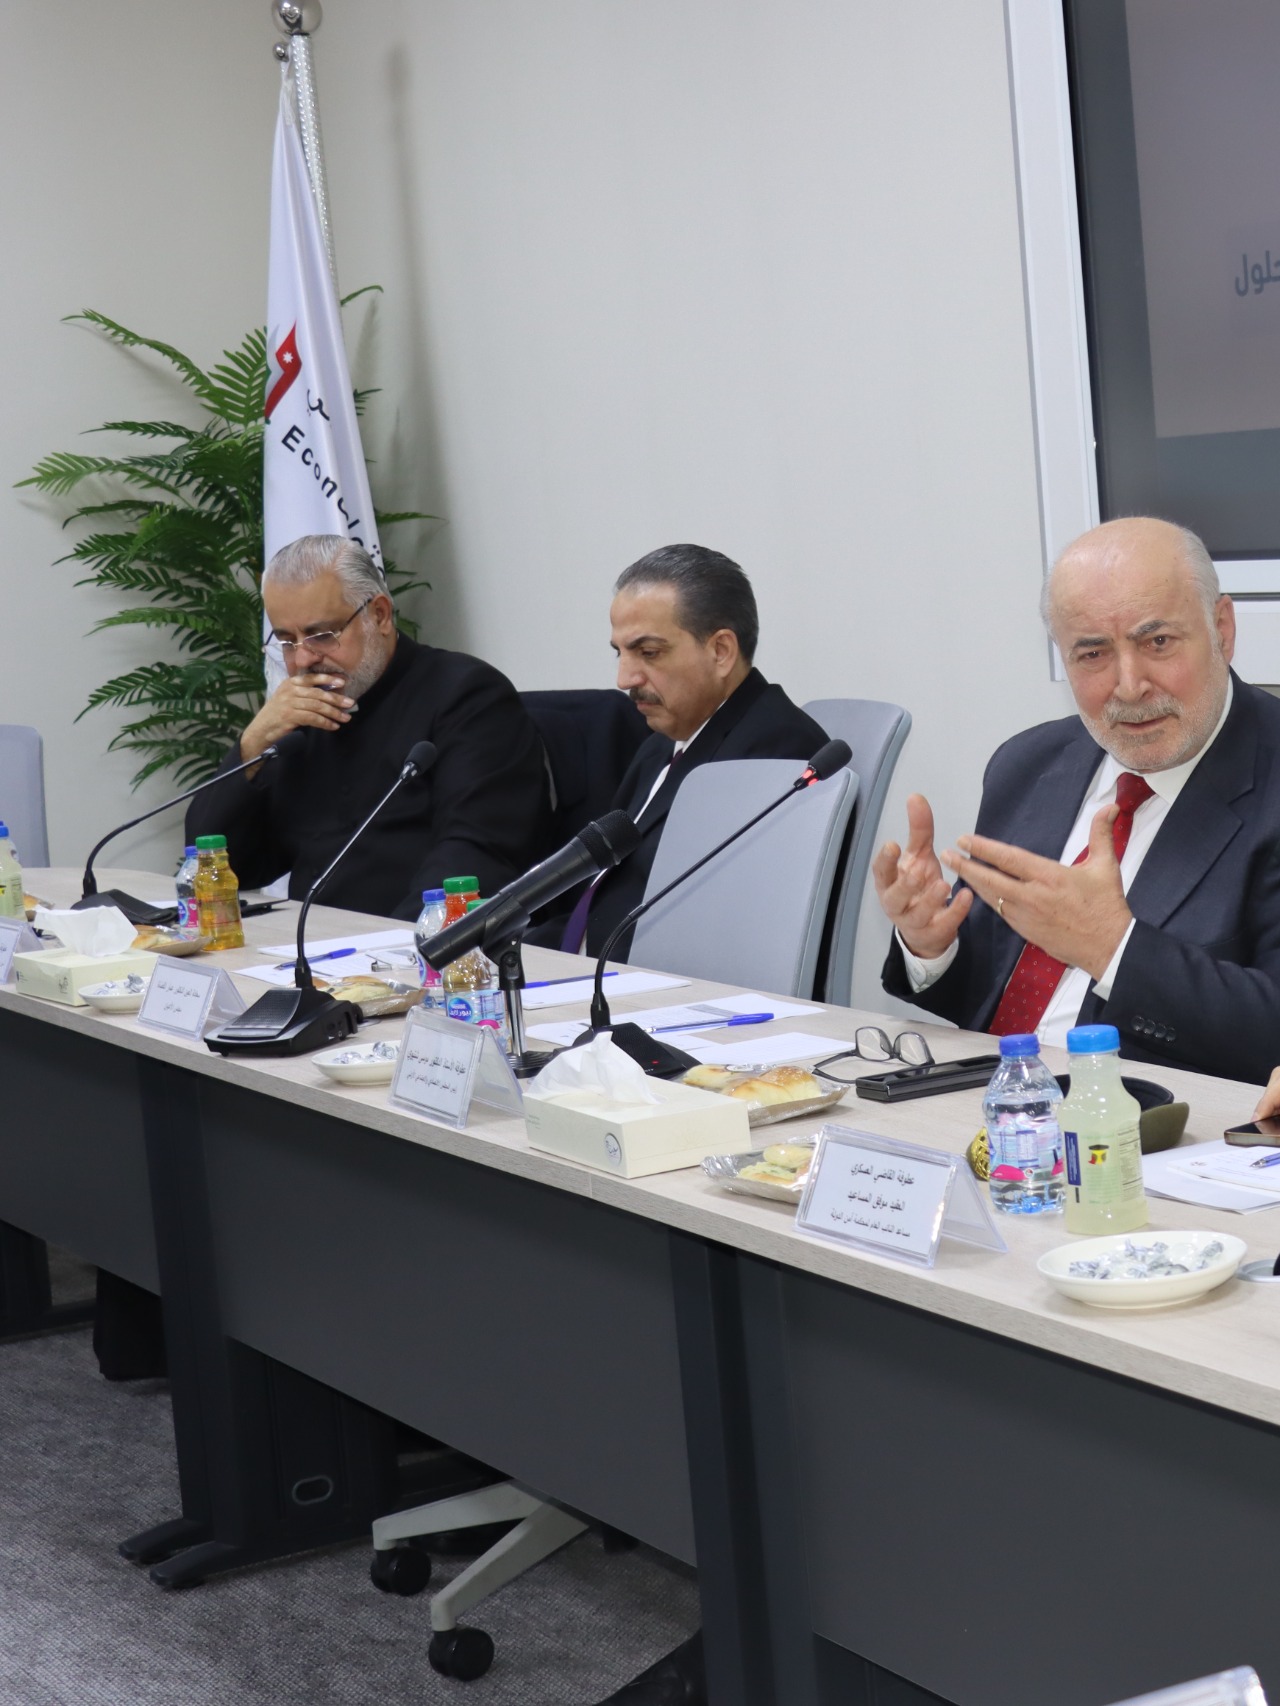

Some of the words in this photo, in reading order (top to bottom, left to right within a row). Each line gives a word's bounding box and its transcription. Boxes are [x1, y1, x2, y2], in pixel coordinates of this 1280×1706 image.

[850, 1163, 874, 1176] العسكري
[873, 1166, 896, 1183] القاضي
[897, 1169, 914, 1186] عطوفة
[848, 1191, 872, 1203] المساعيد
[872, 1194, 888, 1210] موفق
[889, 1198, 906, 1212] العقيد
